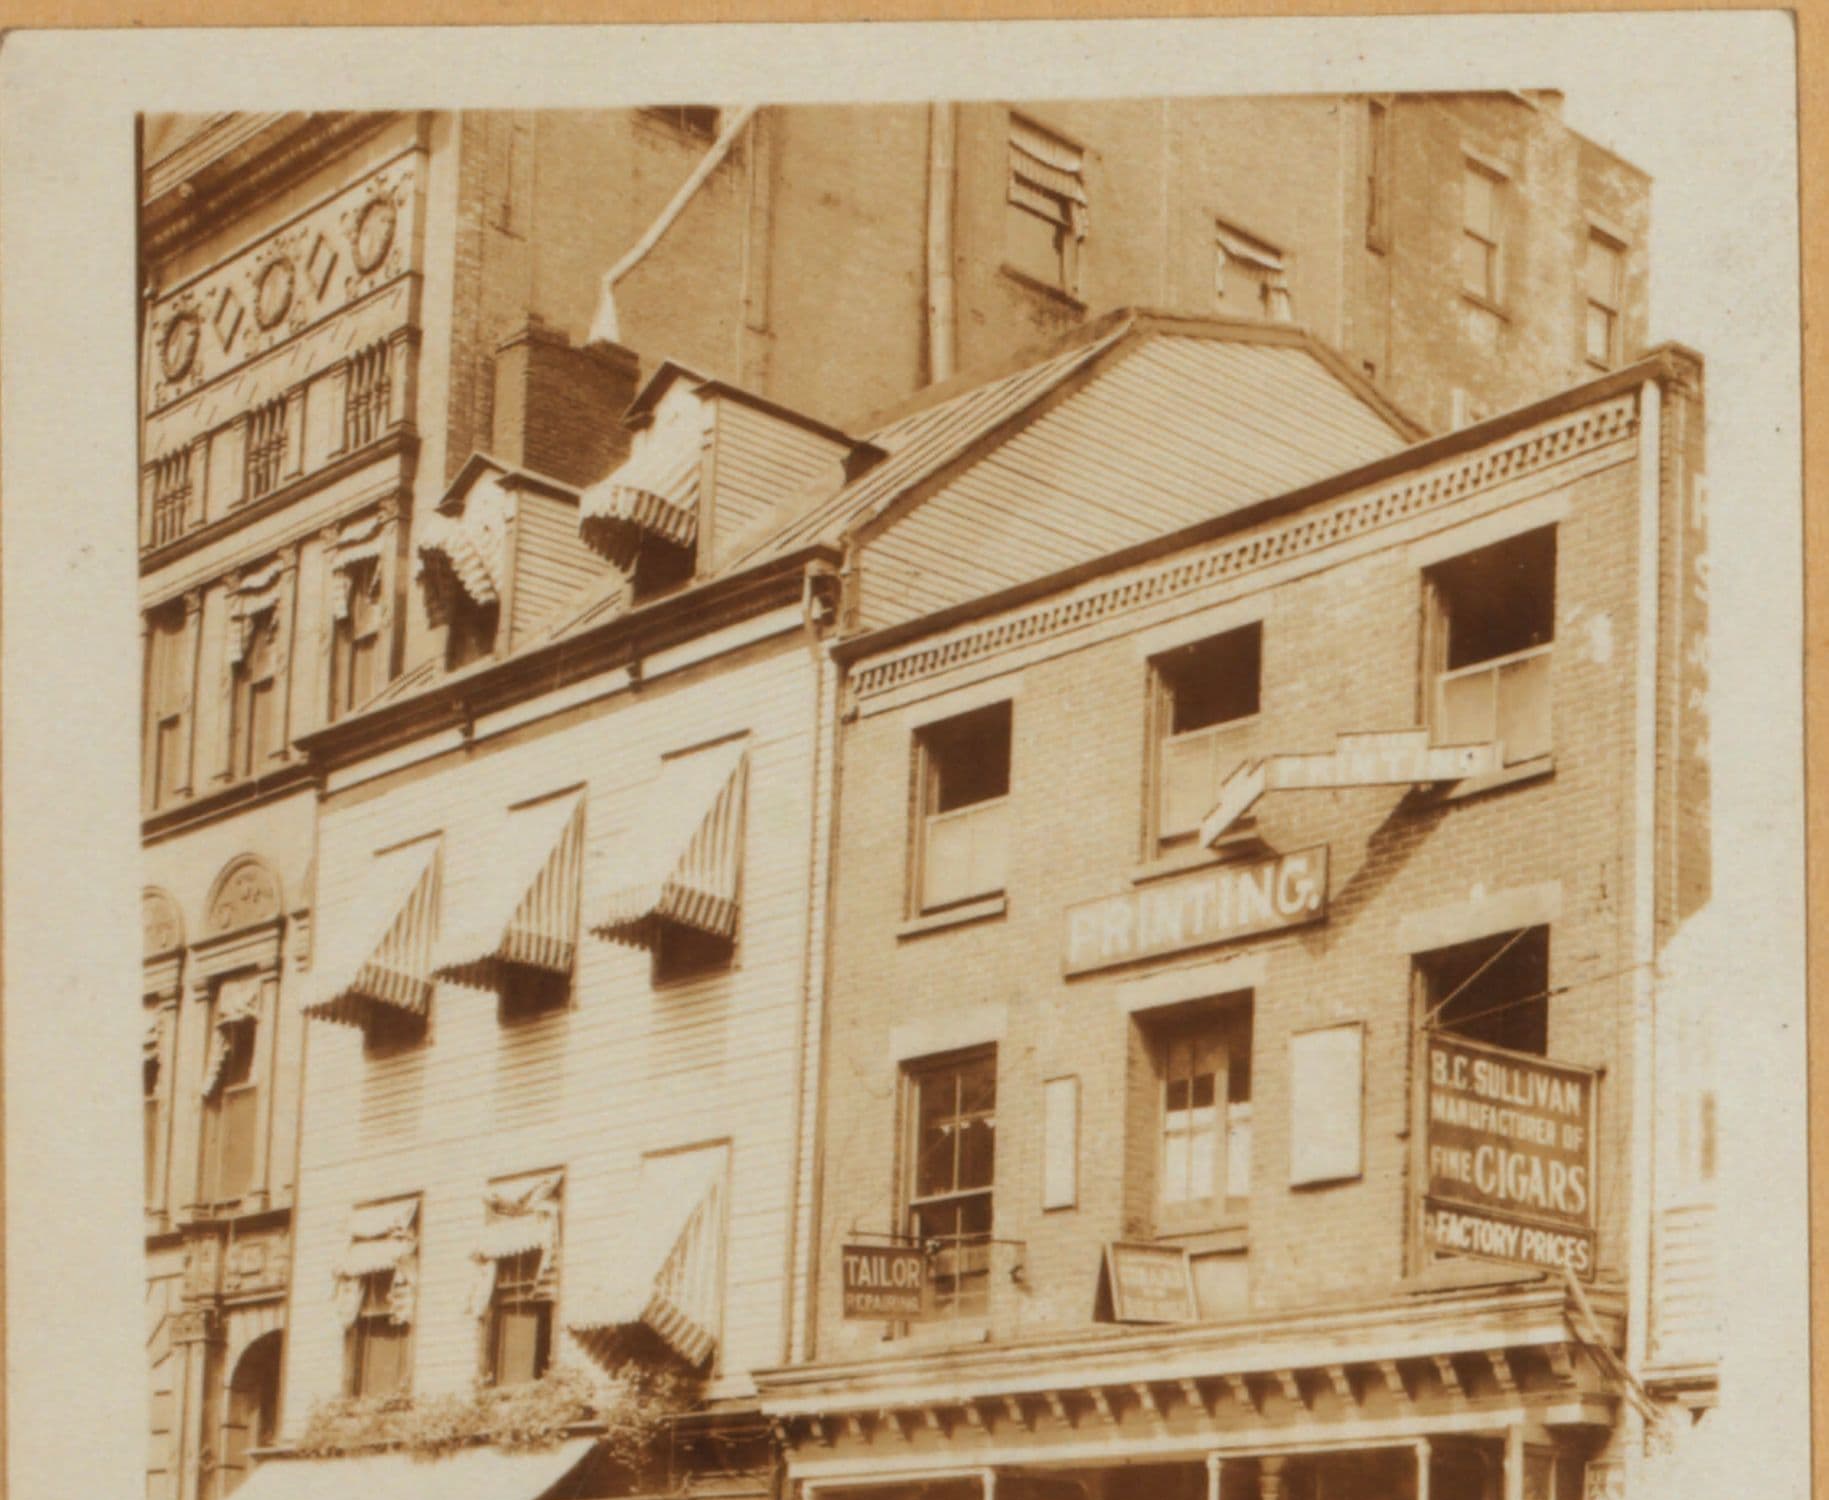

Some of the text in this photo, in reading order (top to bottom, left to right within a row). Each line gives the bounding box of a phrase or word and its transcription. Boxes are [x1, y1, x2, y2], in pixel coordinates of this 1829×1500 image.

[1474, 1060, 1581, 1116] SULLIVAN
[1431, 1094, 1584, 1153] MANUFACTURER OF
[1431, 1145, 1586, 1214] FINE CIGARS
[1435, 1210, 1521, 1258] FACTORY
[1521, 1228, 1589, 1270] PRICES
[844, 1256, 920, 1288] TAILOR
